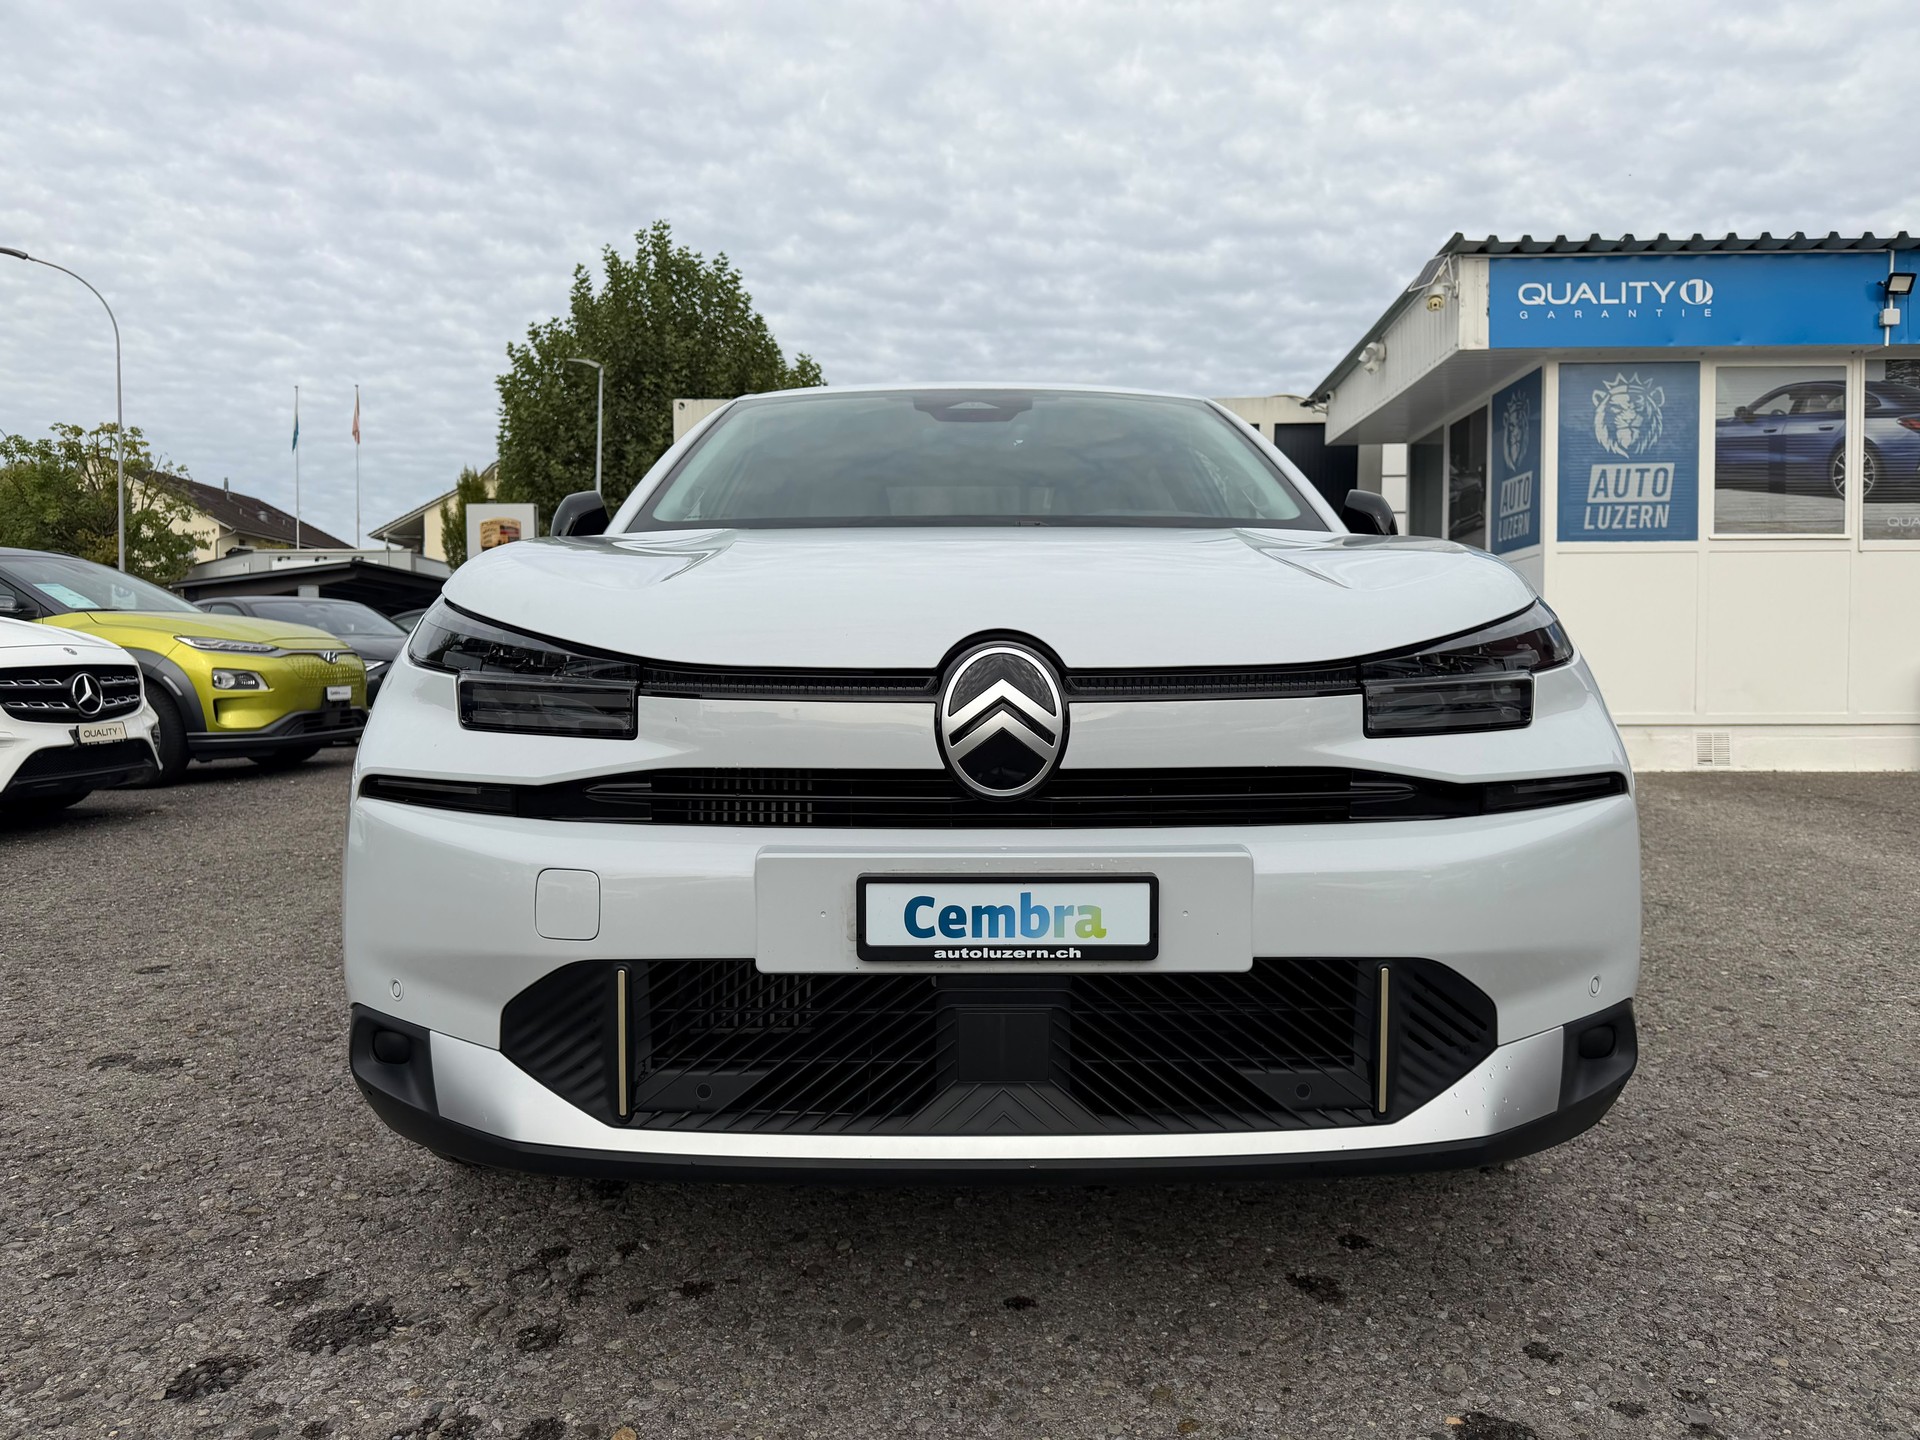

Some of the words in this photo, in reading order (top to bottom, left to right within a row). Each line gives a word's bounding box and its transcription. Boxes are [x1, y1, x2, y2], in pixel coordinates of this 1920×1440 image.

[1518, 281, 1676, 305] QUALITY
[1519, 309, 1712, 319] GARANTIE
[1502, 476, 1530, 514] AUTO
[1591, 467, 1669, 498] AUTO
[1498, 511, 1530, 542] LUZERN
[1583, 504, 1670, 530] LUZERN
[904, 892, 1107, 939] Cembra
[934, 948, 1081, 959] autoluzern.ch
